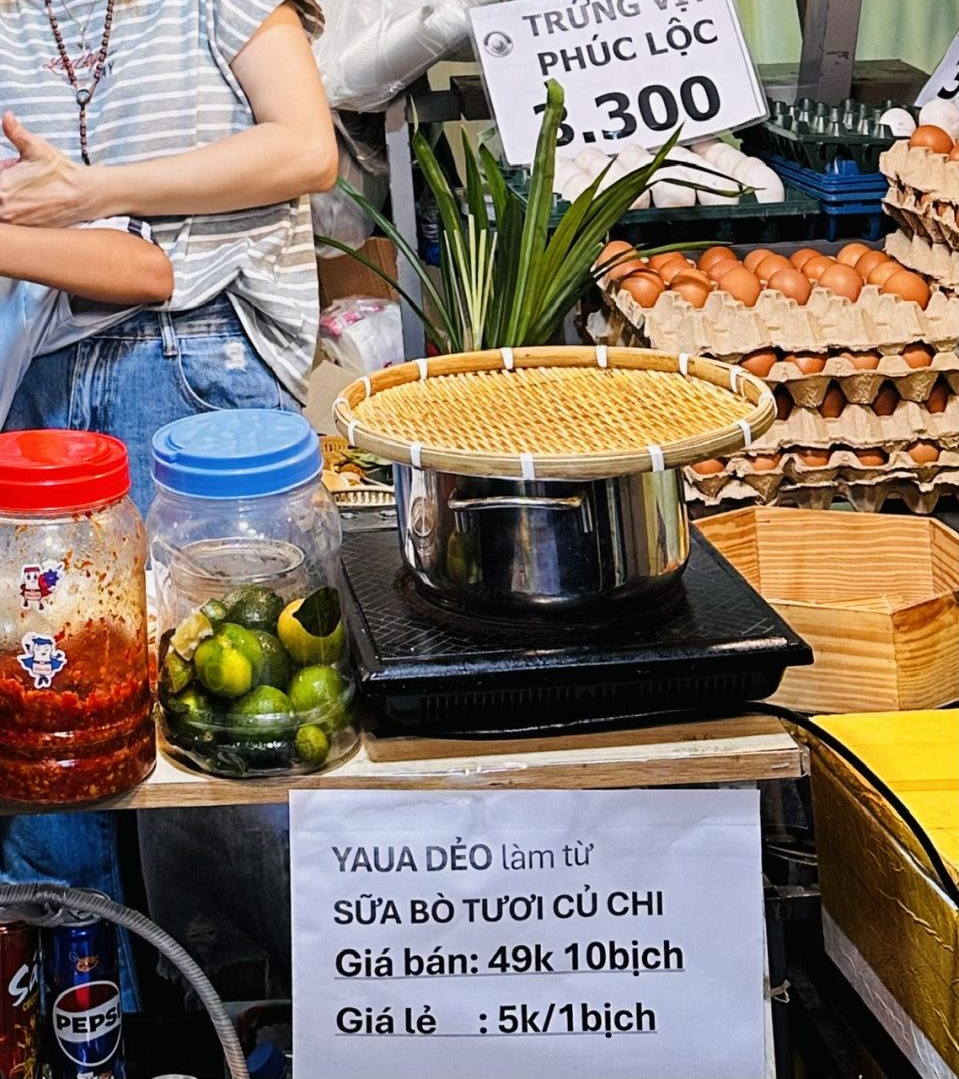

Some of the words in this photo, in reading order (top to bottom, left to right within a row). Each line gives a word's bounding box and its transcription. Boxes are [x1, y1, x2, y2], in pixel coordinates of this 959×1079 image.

[537, 34, 638, 76] PHÚC
[645, 16, 718, 56] LỘC
[332, 846, 418, 873] YAUA
[426, 837, 492, 872] DẺO
[501, 844, 555, 871] làm
[562, 840, 595, 868] từ
[333, 894, 402, 926] SỮA
[410, 892, 455, 924] BÒ
[462, 894, 544, 924] TƯƠI
[552, 884, 598, 919] CỦ
[607, 890, 665, 918] CHI
[334, 947, 393, 978] Giá
[404, 944, 480, 977] bán:
[488, 943, 554, 974] 49k
[564, 940, 684, 978] 10bịch
[335, 1006, 395, 1035] Giá
[405, 1004, 437, 1035] lẻ
[497, 1002, 656, 1039] 5k/1bịch
